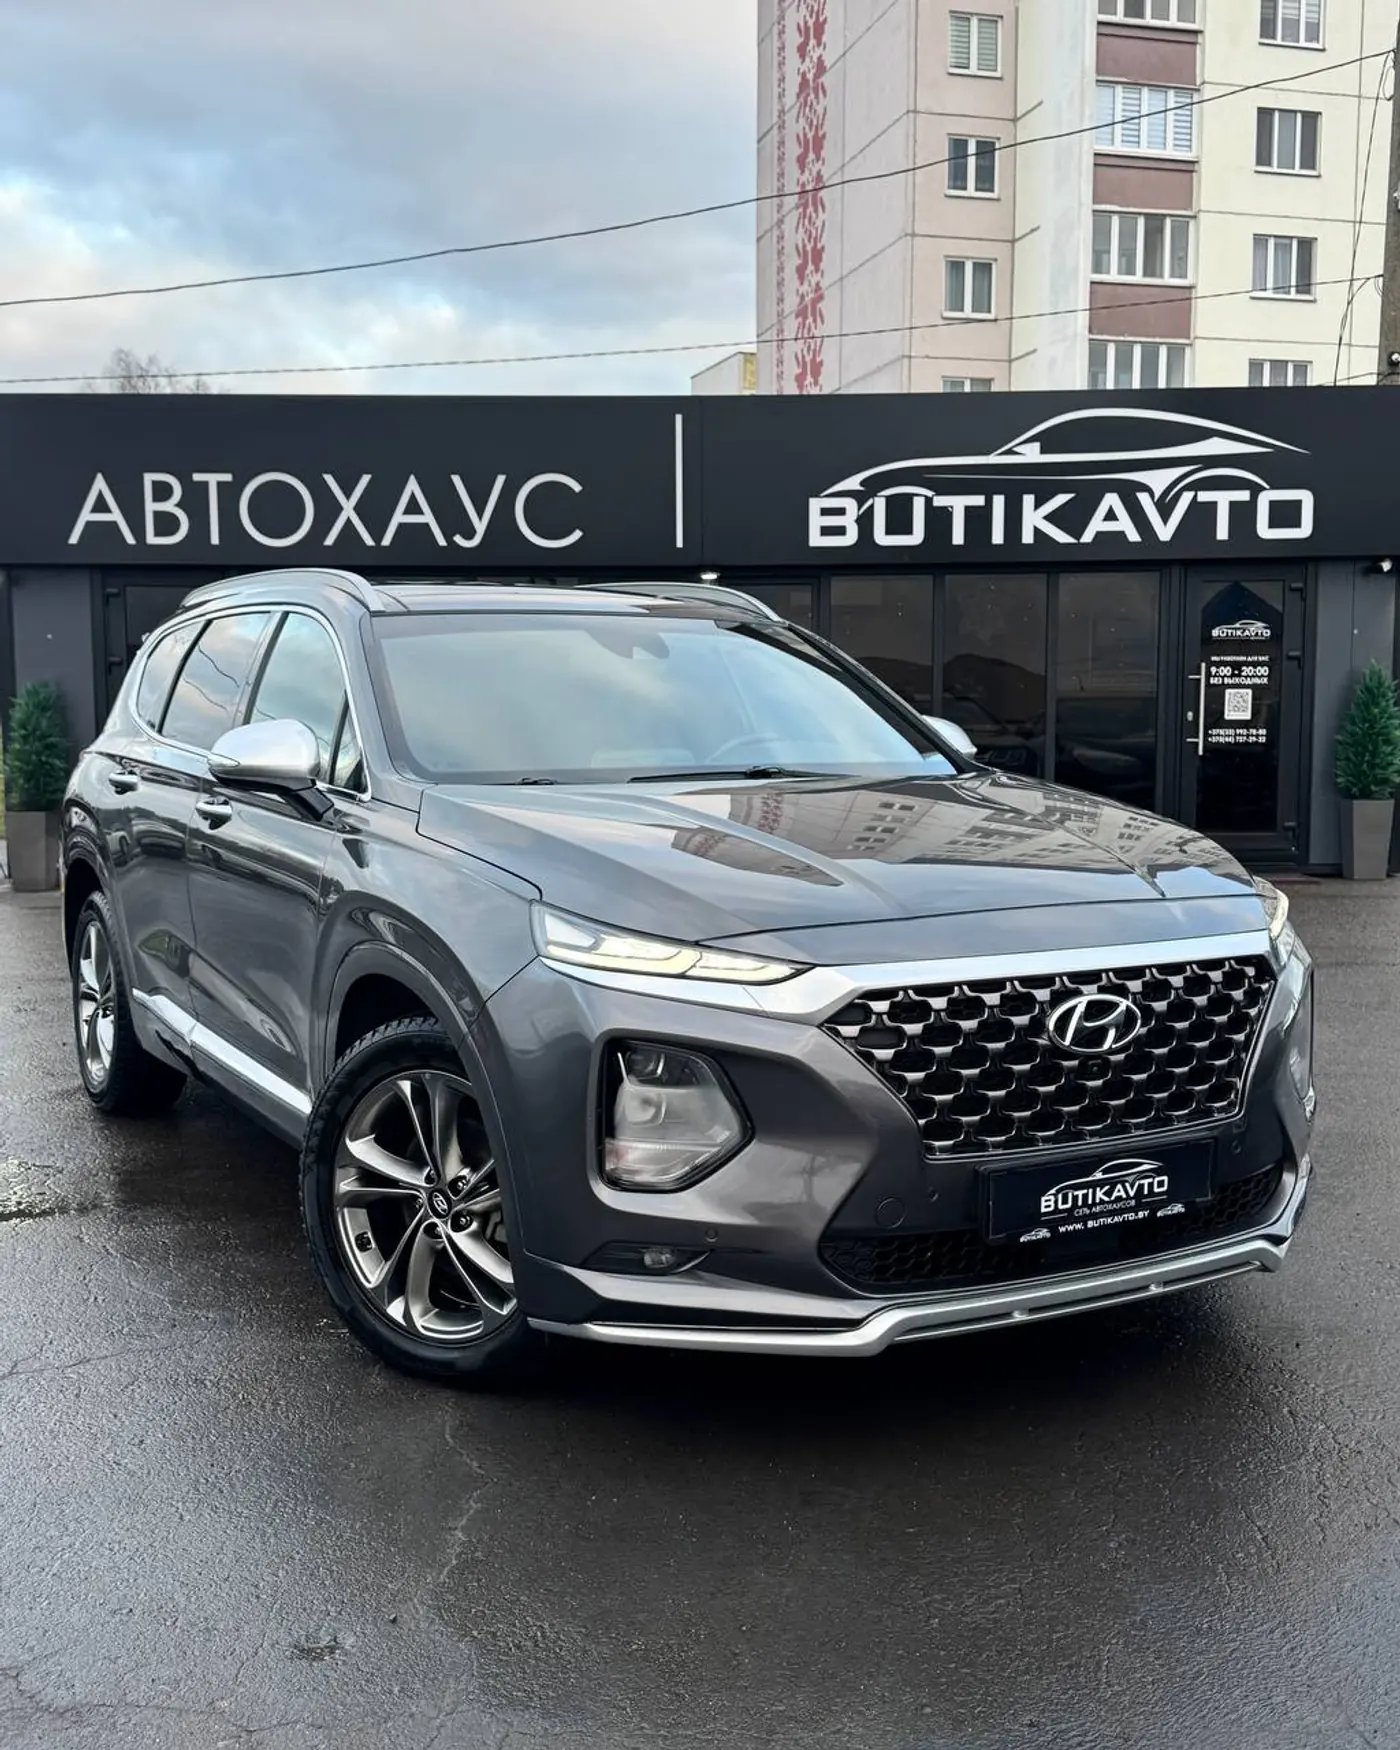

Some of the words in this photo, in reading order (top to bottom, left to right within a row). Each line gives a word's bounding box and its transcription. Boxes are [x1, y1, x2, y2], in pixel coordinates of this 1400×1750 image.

[67, 471, 584, 548] АВТОХАУС
[808, 488, 1314, 548] BUTIKAVTO
[1211, 628, 1271, 637] BUTIKAVTO
[1210, 666, 1232, 676] 9:00
[1241, 666, 1269, 676] 20:00
[1224, 677, 1269, 685] ВЫХОДНЫХ
[1040, 1175, 1169, 1213] BUTIKAVTO
[1073, 1207, 1091, 1217] СЕТЬ
[1091, 1199, 1136, 1213] АВТОХАУСОВ
[1087, 1210, 1150, 1229] BUTIKAVTO.BY
